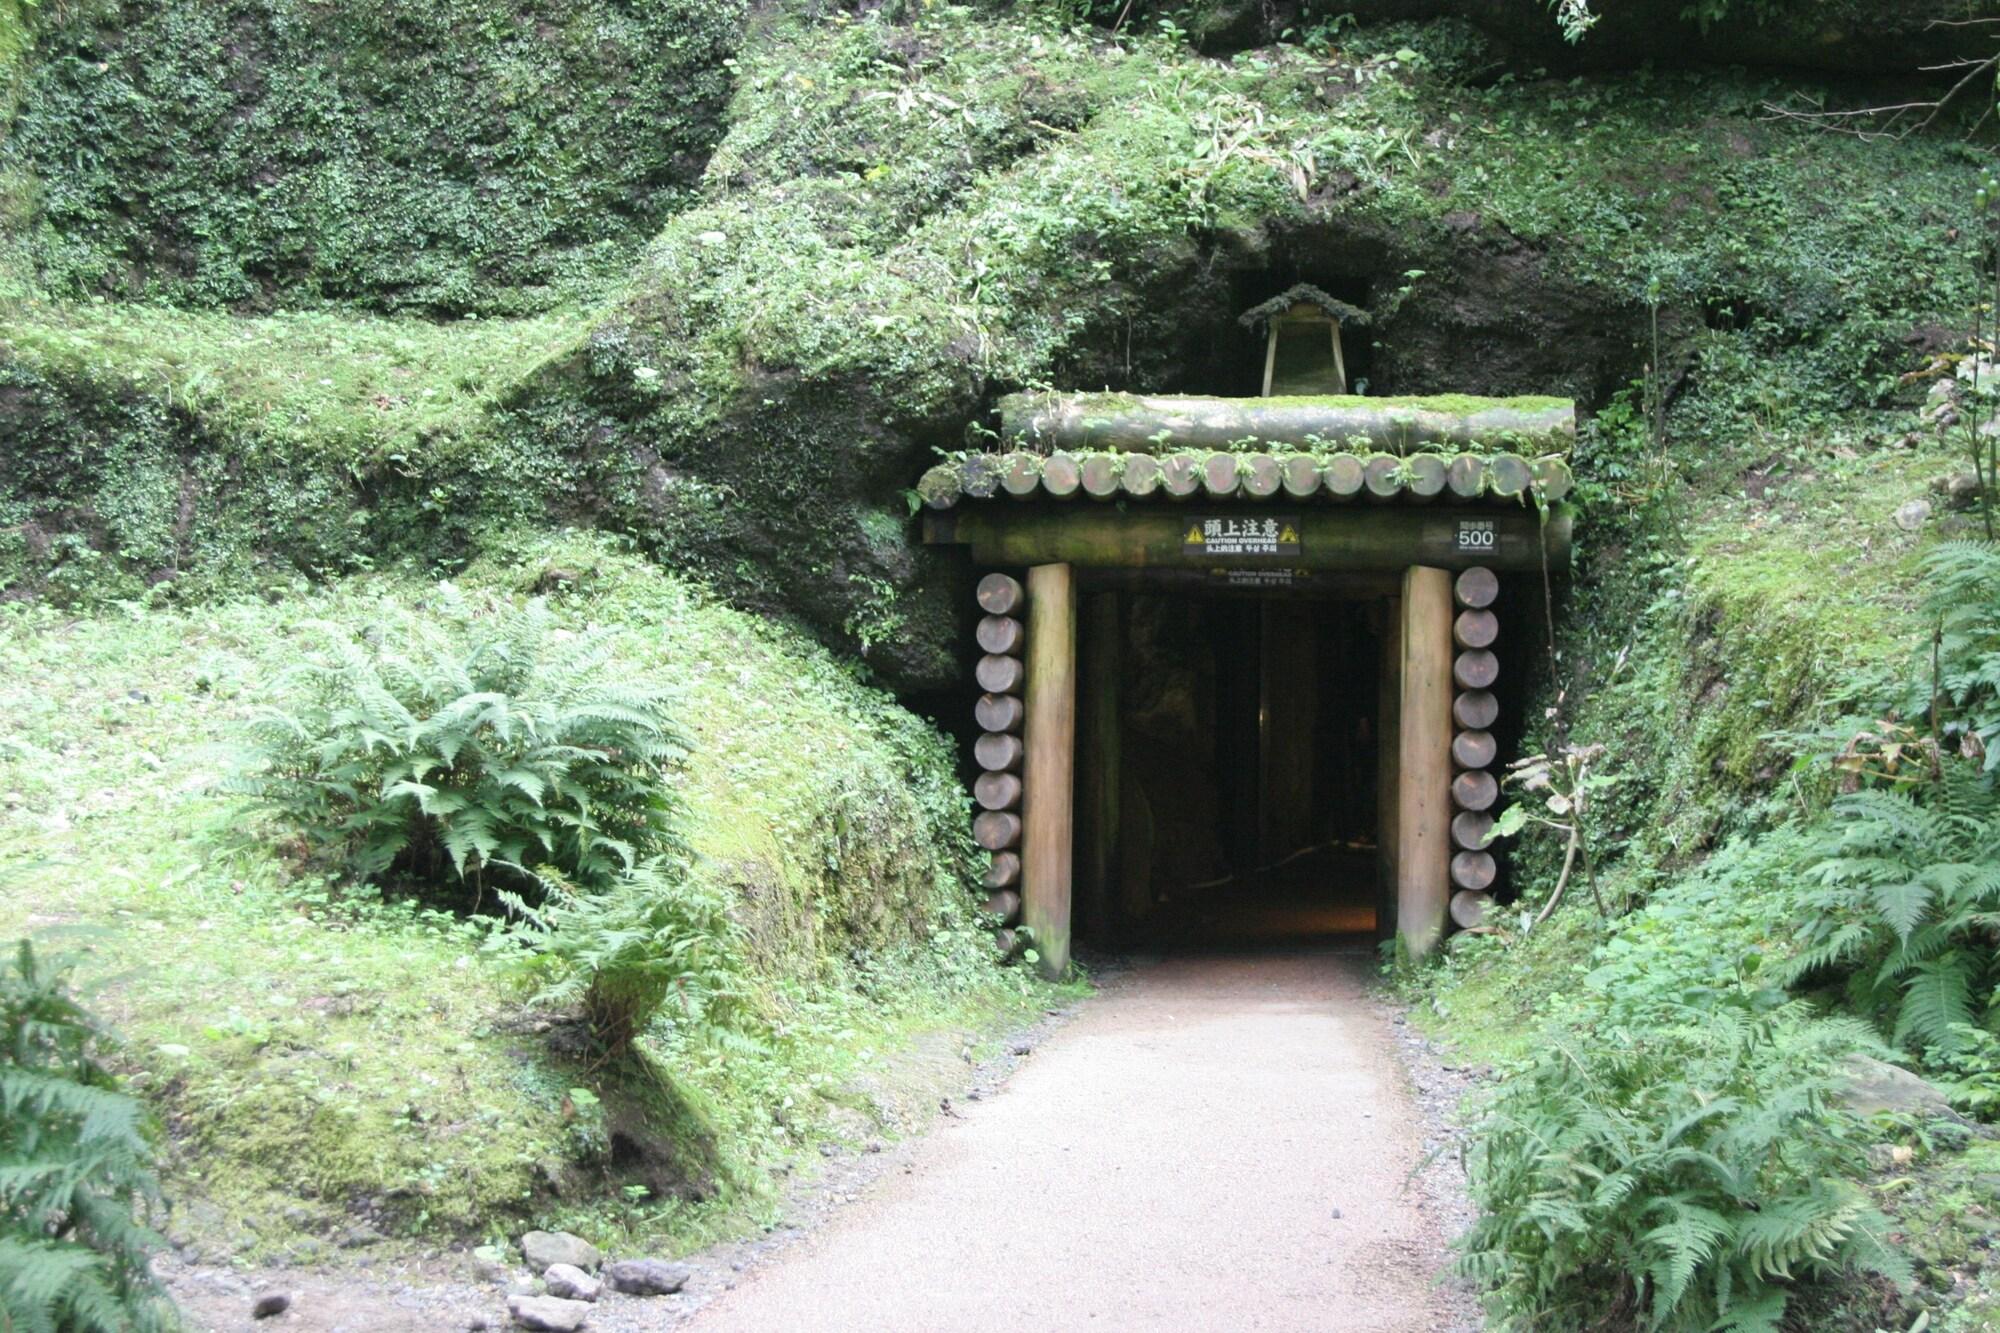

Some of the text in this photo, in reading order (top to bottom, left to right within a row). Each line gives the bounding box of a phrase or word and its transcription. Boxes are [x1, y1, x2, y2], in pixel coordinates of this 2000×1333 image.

[1204, 518, 1279, 537] 頭上注意
[1459, 530, 1494, 546] 500
